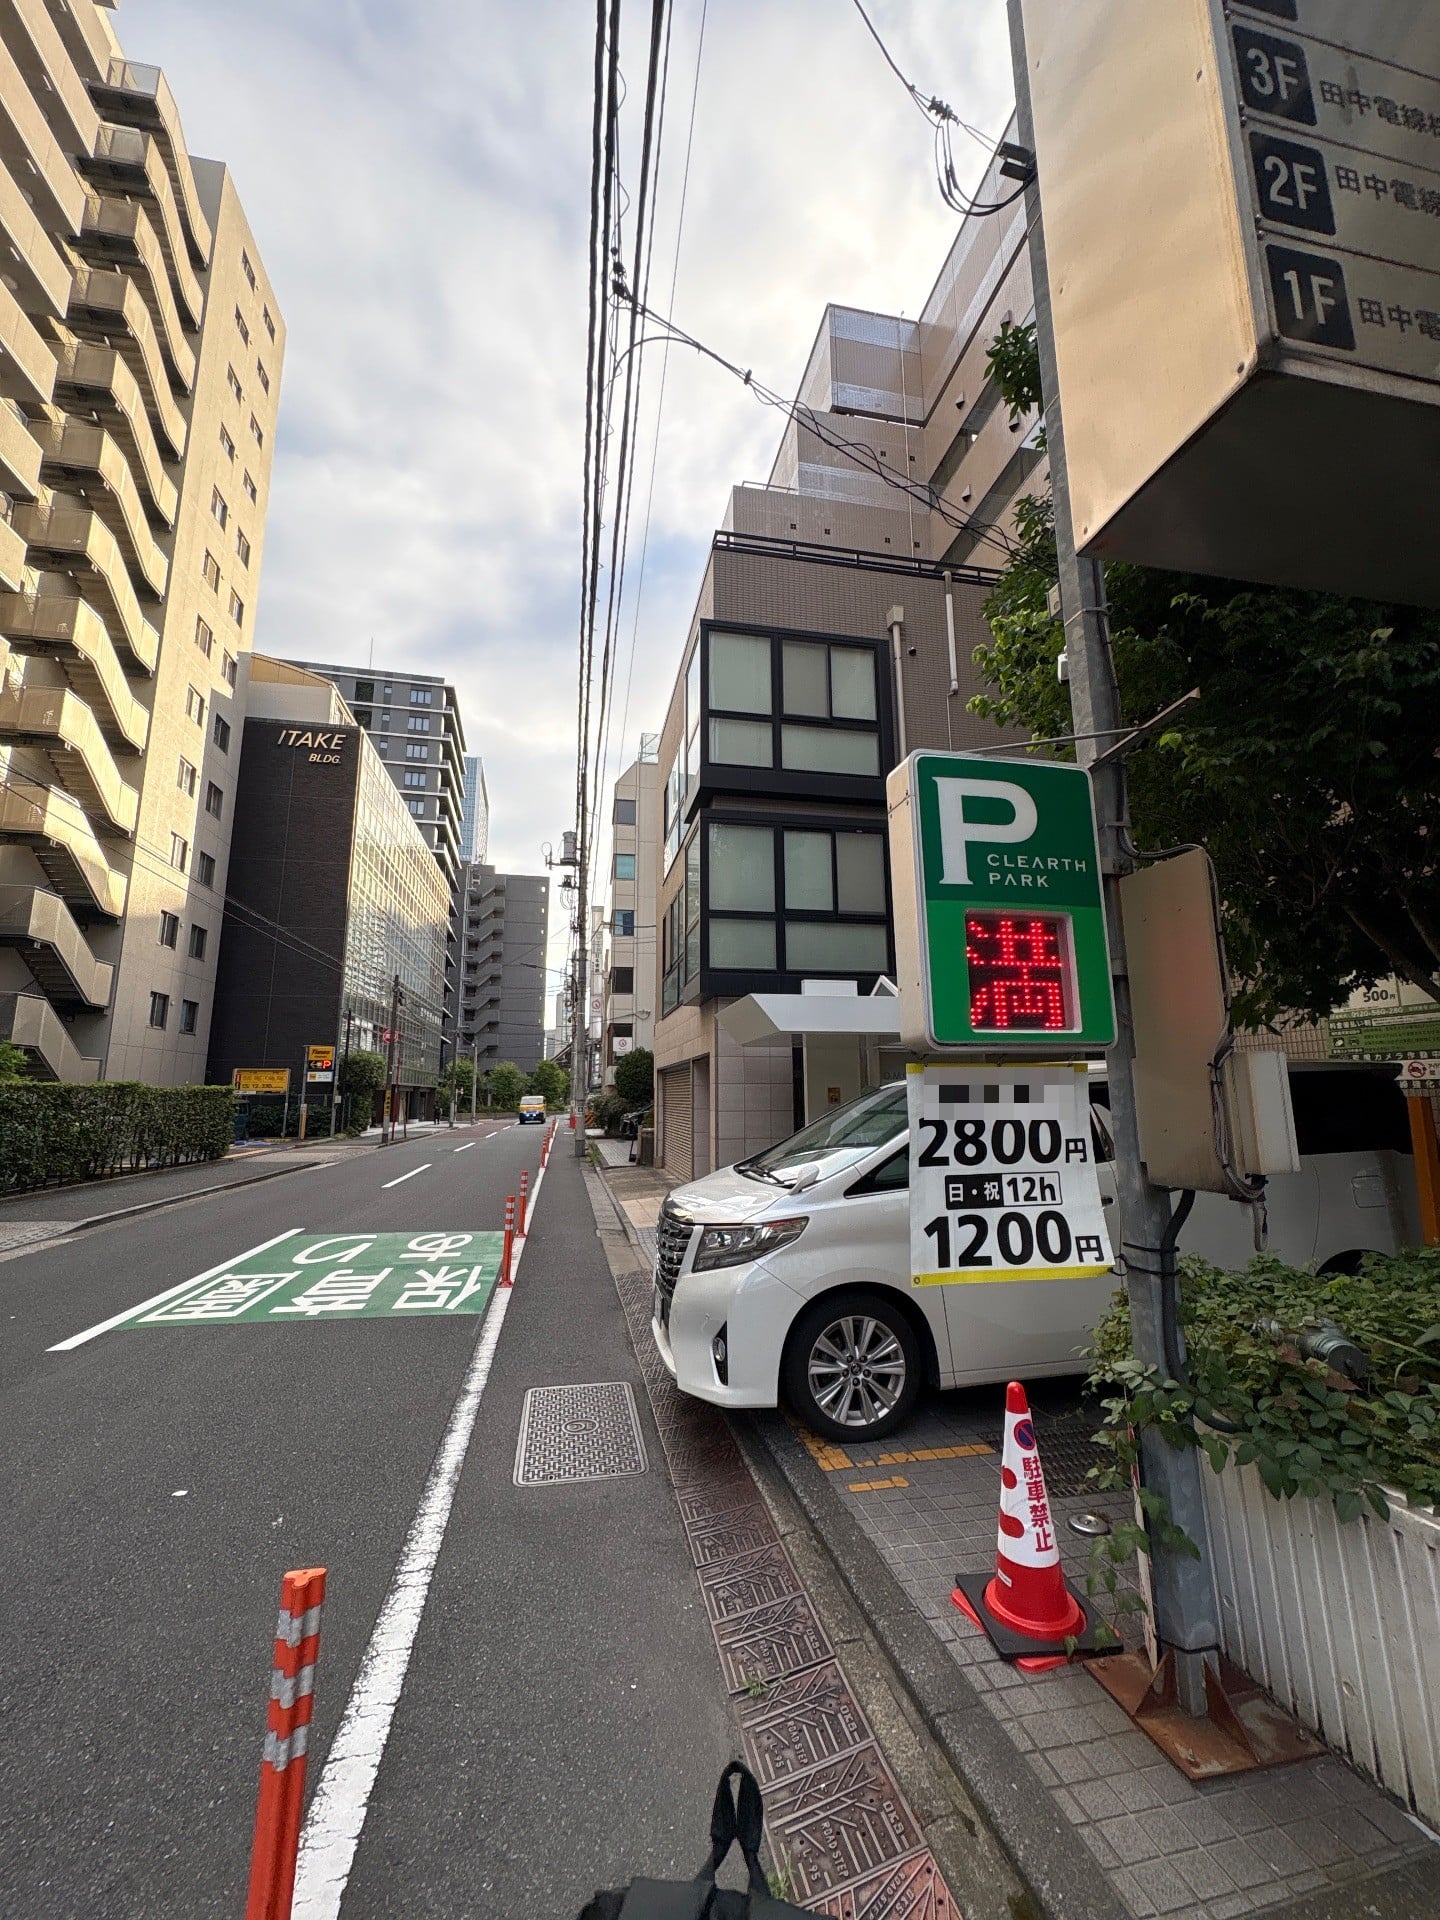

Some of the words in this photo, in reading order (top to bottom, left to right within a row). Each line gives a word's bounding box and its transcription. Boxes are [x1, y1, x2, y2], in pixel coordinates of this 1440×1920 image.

[1246, 48, 1298, 101] 3F
[1264, 155, 1316, 210] 2F
[1283, 270, 1335, 325] 1F
[277, 729, 347, 750] ITAKE
[308, 753, 342, 764] BLDG.
[932, 776, 1038, 885] P
[987, 853, 1086, 872] CLEARTH
[988, 872, 1050, 888] PARK
[966, 920, 1063, 1031] 満
[1006, 1176, 1057, 1203] 12h
[923, 1210, 1104, 1268] 1200円
[1022, 1455, 1054, 1553] 駐車禁止
